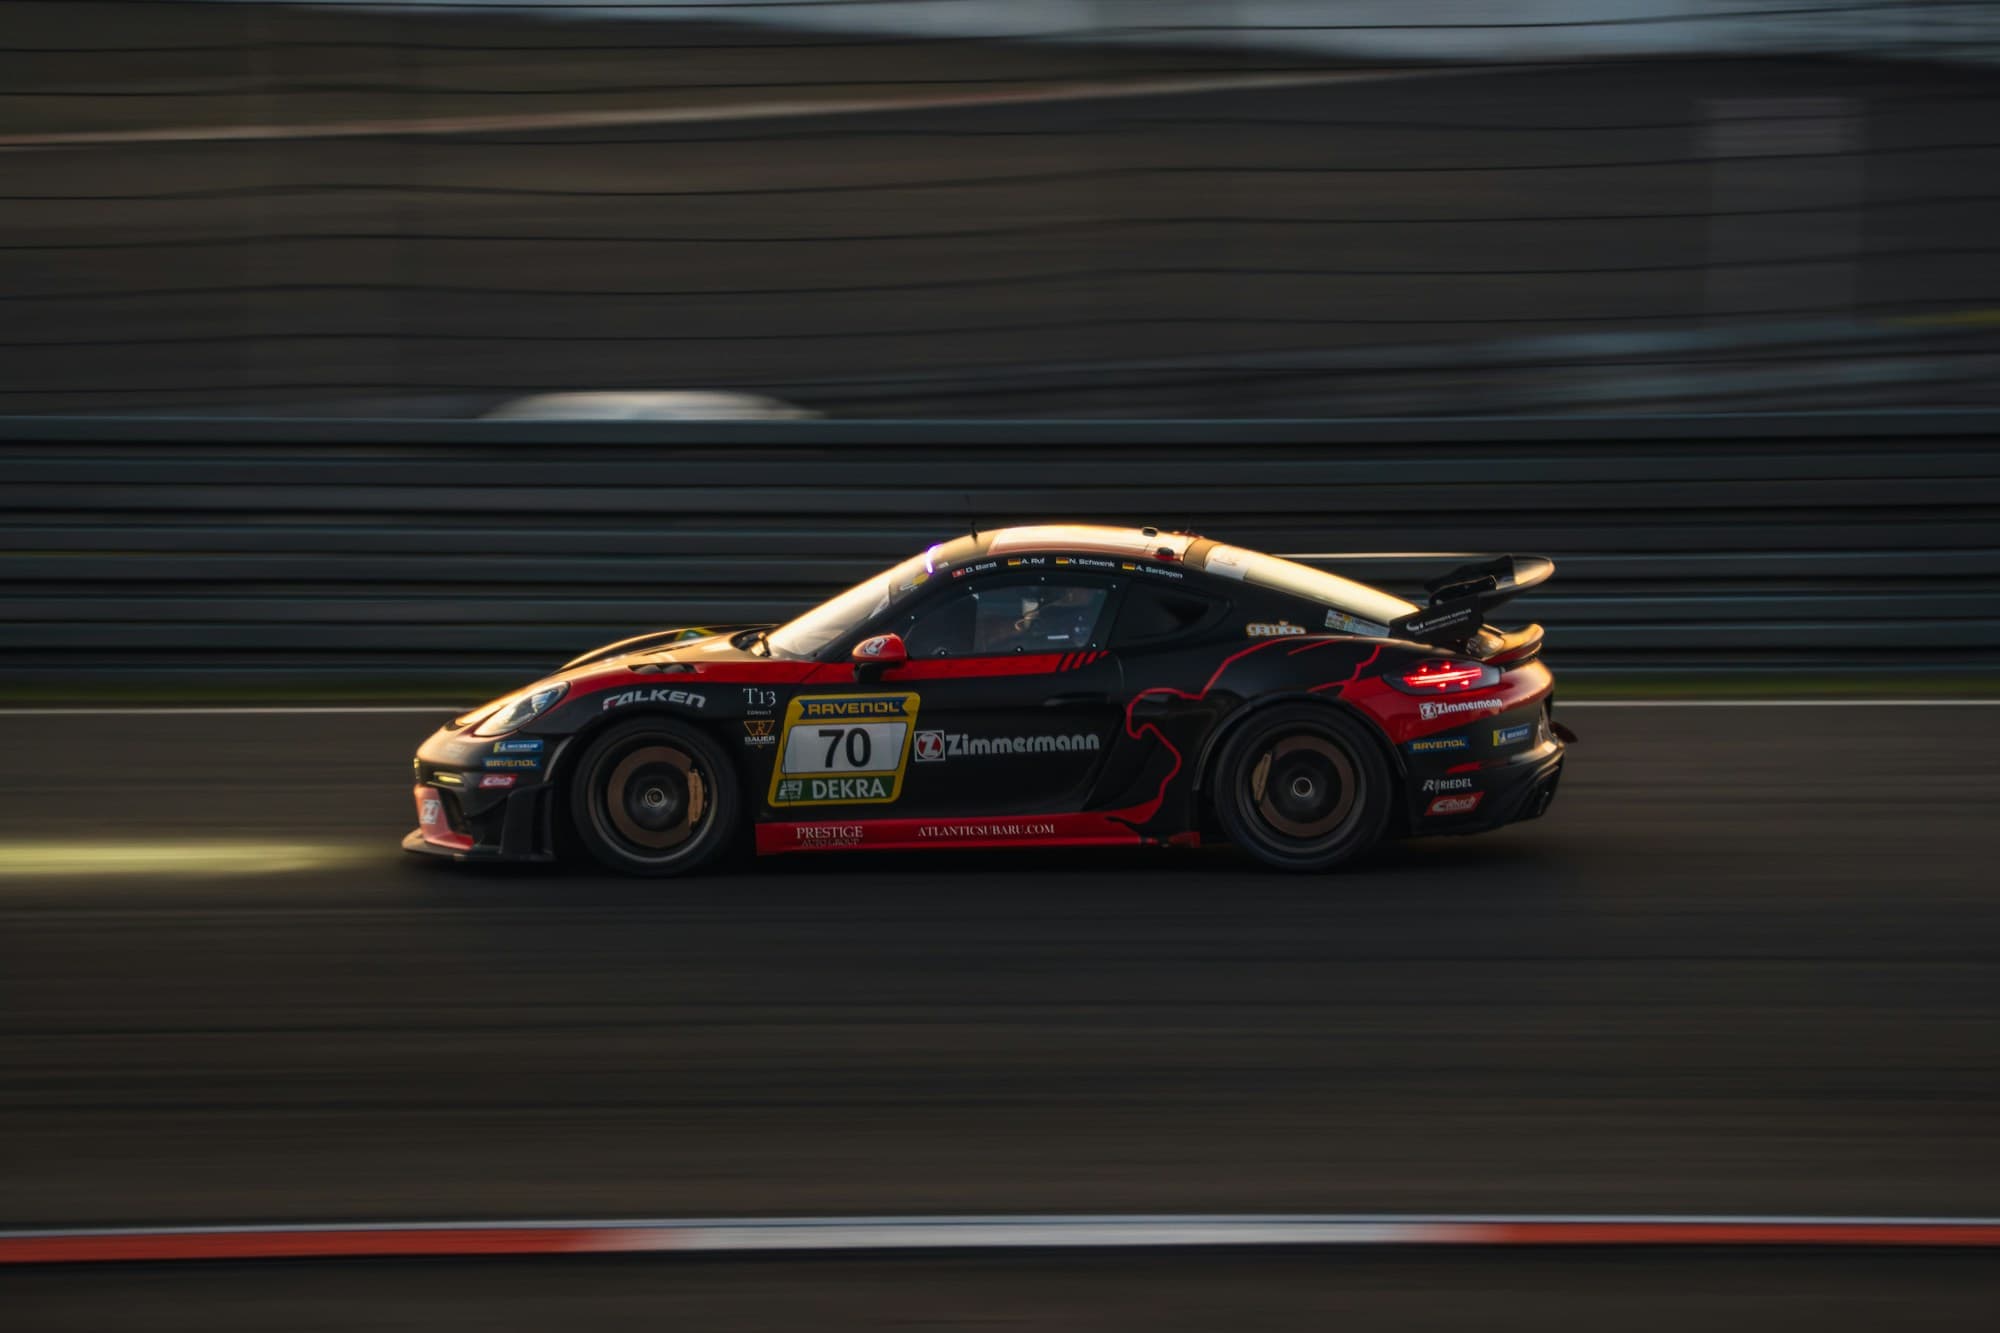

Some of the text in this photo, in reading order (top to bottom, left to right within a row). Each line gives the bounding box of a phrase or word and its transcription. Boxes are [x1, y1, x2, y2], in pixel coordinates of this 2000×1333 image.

[602, 689, 707, 711] FALKEN
[742, 687, 777, 707] T13
[807, 701, 899, 715] RAVENOL
[1436, 698, 1503, 715] Zimmermann
[818, 727, 872, 769] 70
[946, 733, 1100, 756] Zimmermann
[1412, 739, 1466, 751] RAVENOL
[811, 778, 887, 799] DEKRA
[796, 826, 864, 840] PRESTIGE
[917, 823, 1056, 838] ATLANTICSUBARU.COM
